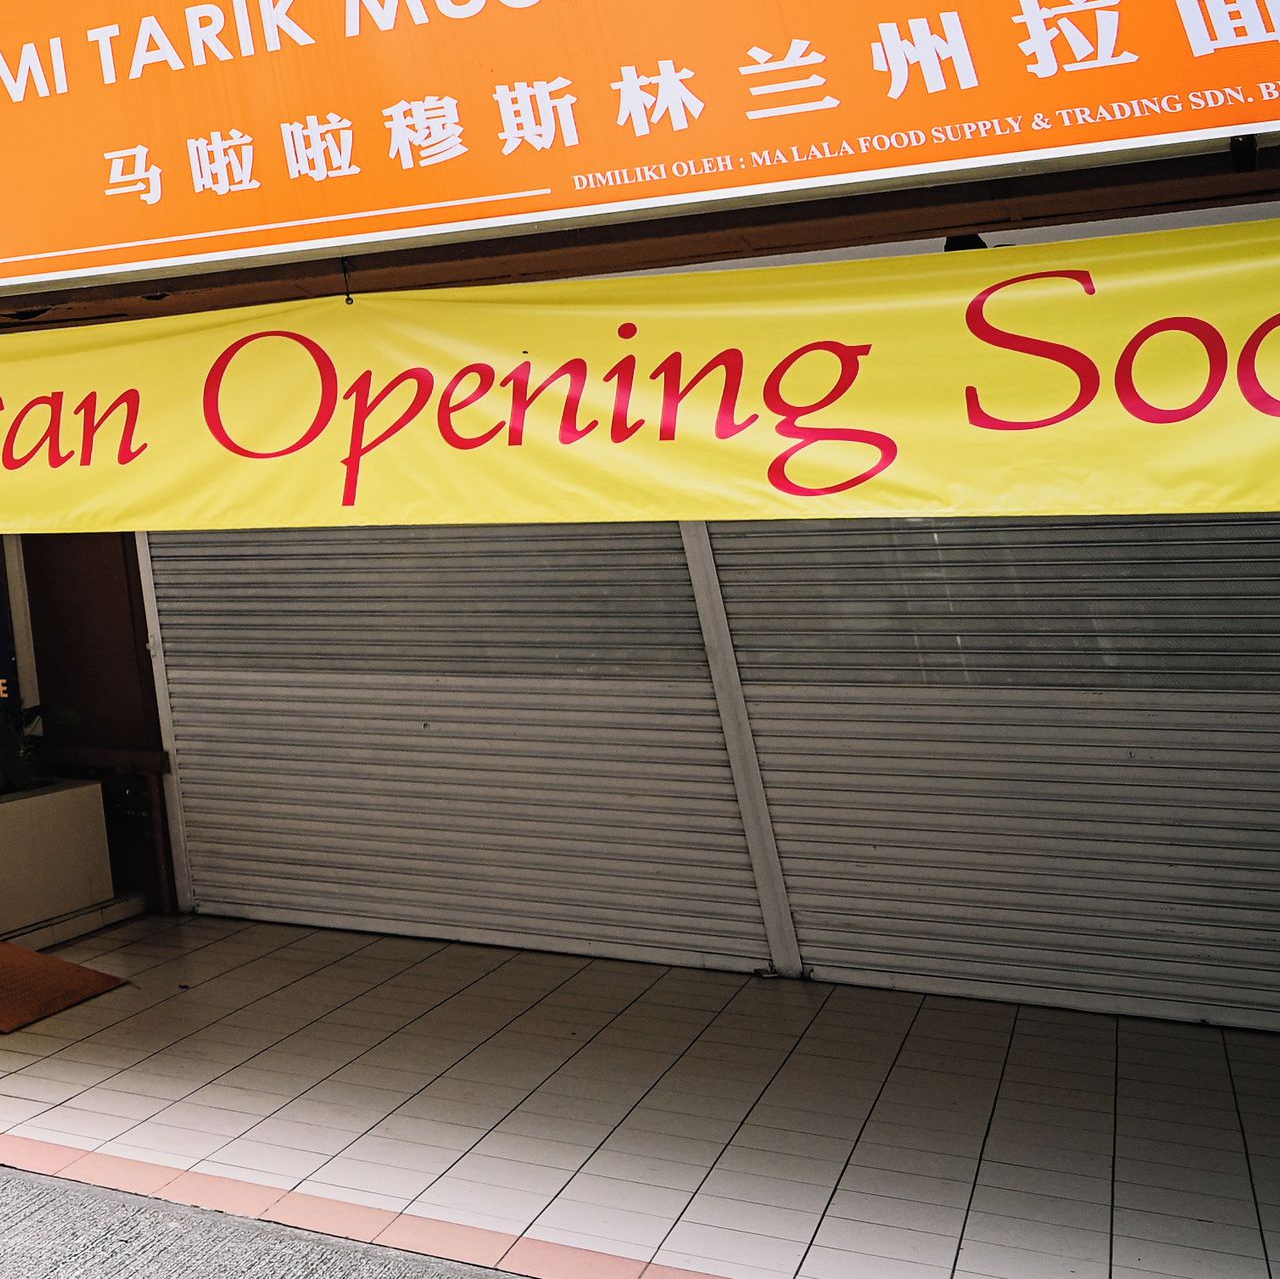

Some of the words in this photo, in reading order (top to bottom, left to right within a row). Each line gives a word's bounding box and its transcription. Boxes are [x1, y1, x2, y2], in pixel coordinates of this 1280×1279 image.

[572, 164, 668, 190] DIMILIKI
[672, 155, 733, 178] OLEH
[858, 129, 927, 153] FOOD
[933, 116, 1024, 145] SUPPLY
[1031, 112, 1053, 131] &
[1056, 94, 1183, 126] TRADING
[1188, 85, 1254, 111] SDN.
[1257, 80, 1280, 101] B
[202, 322, 898, 507] Opening
